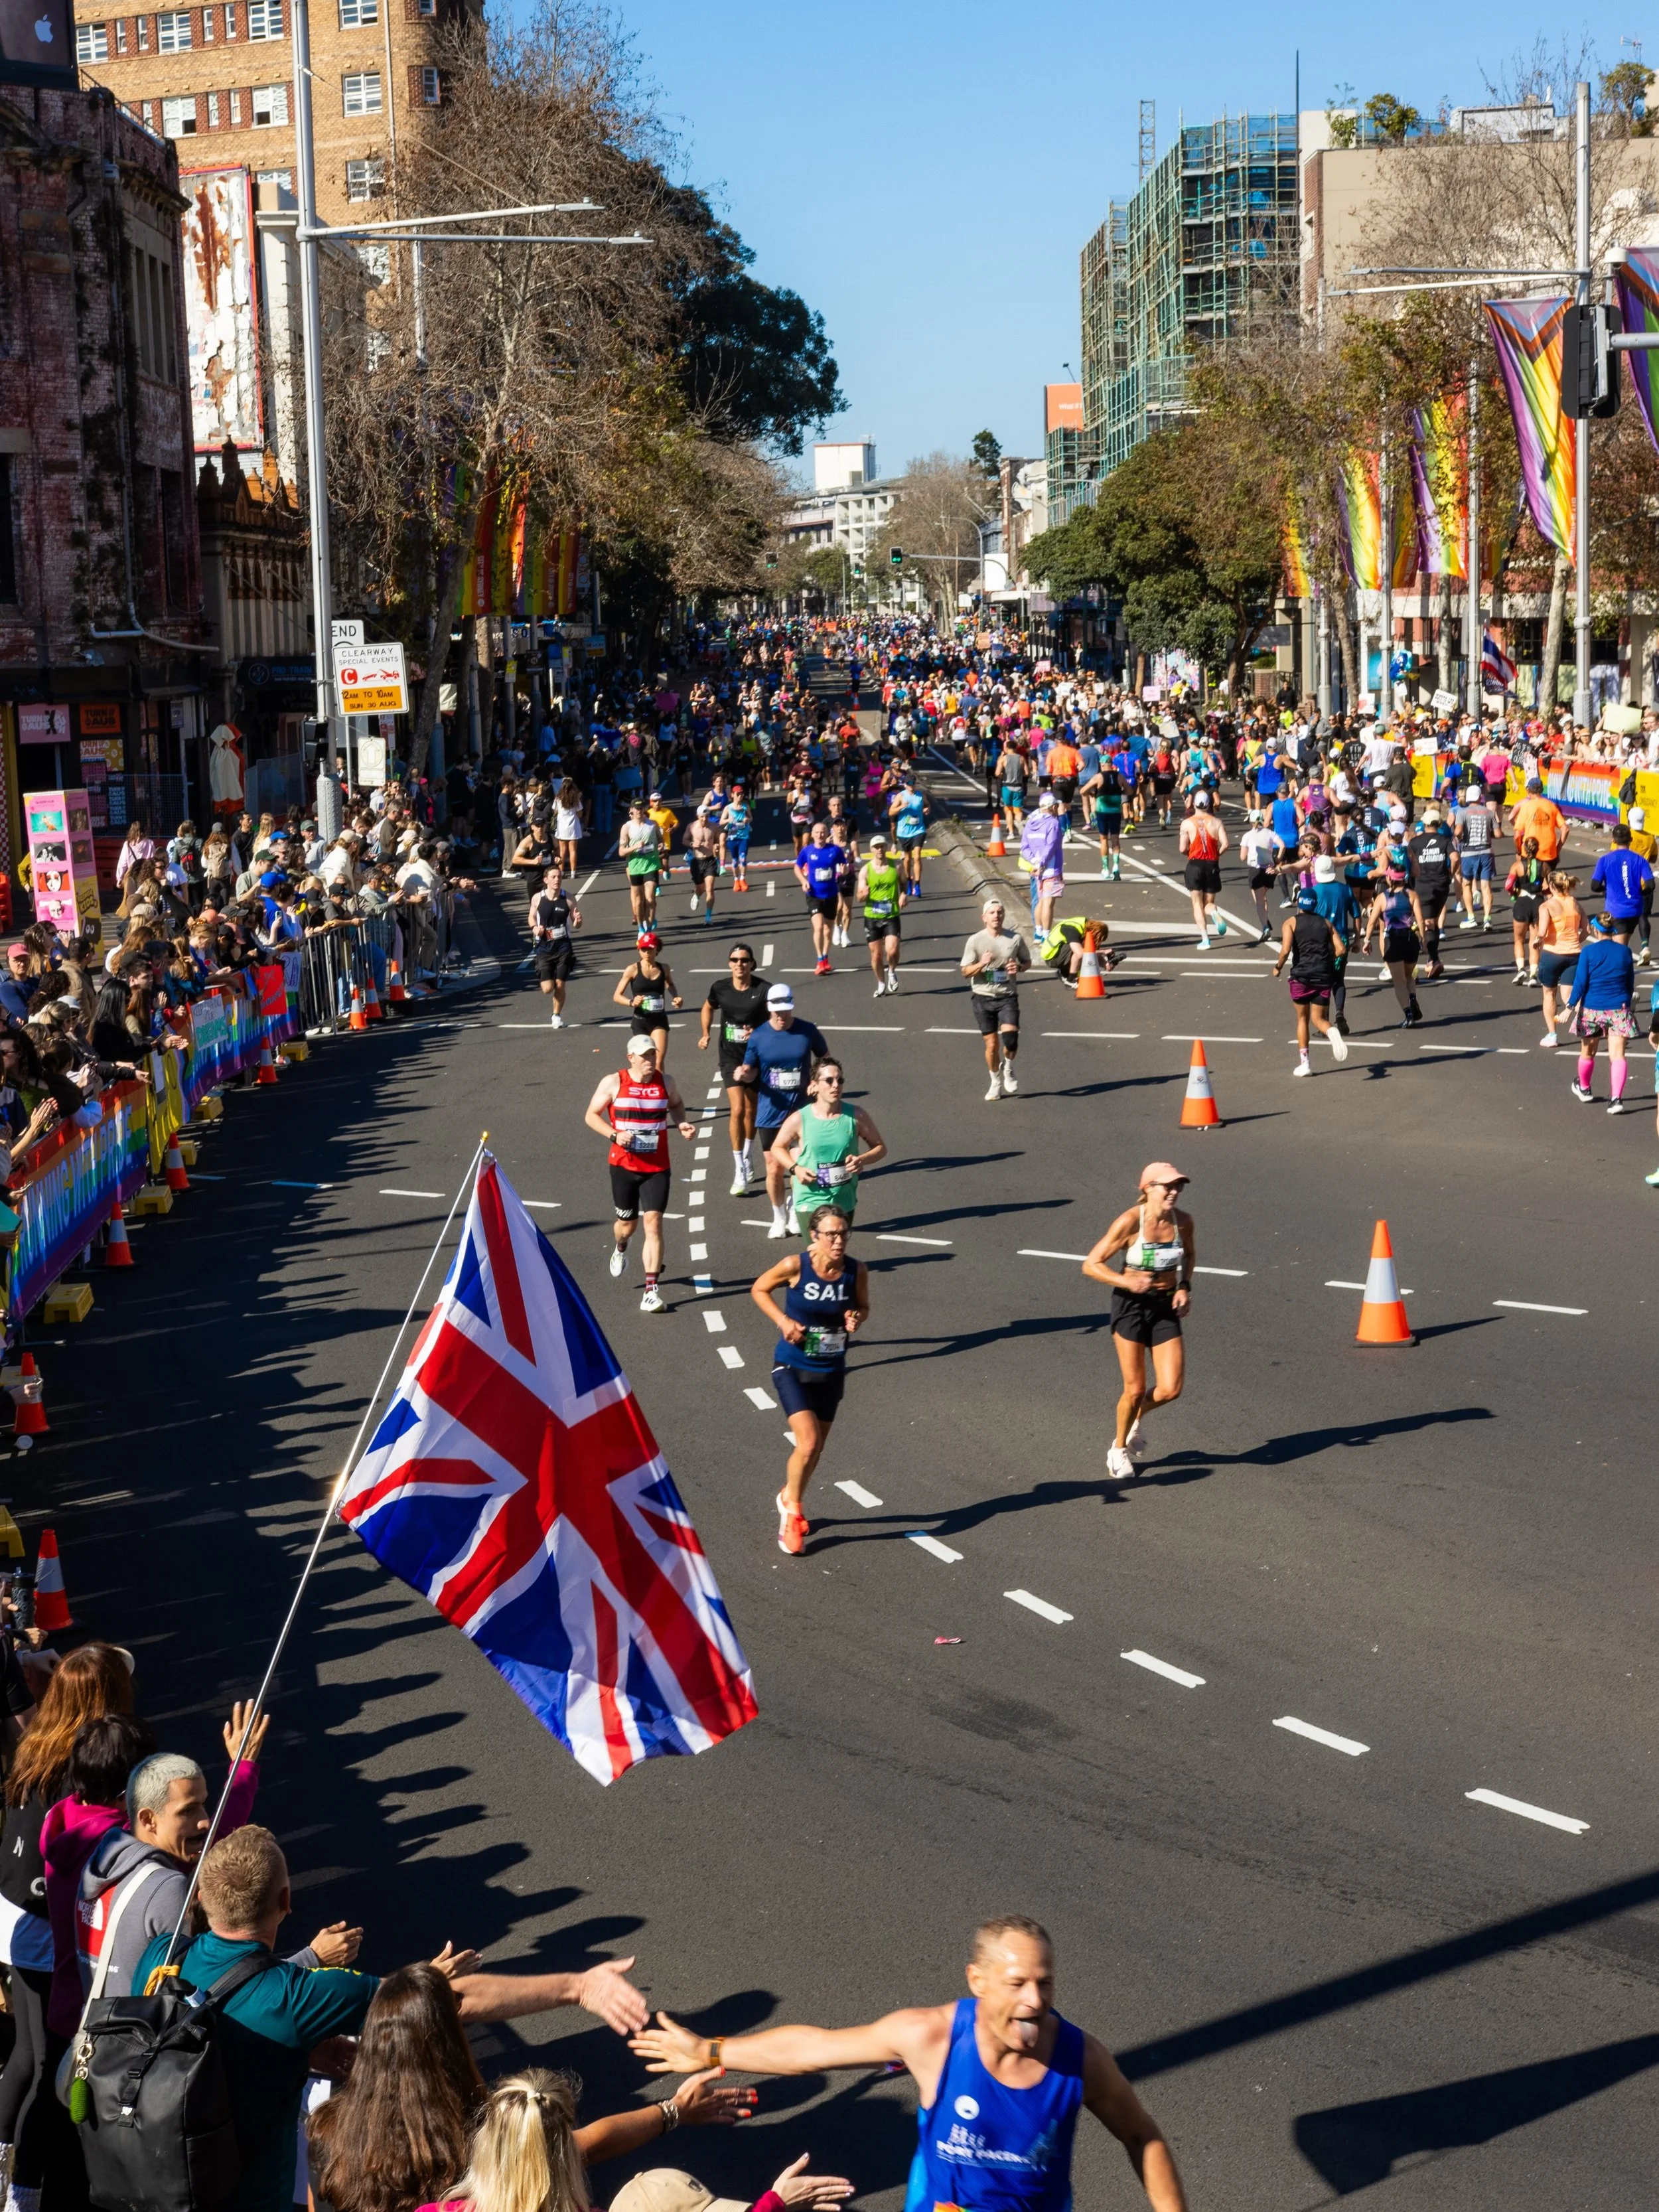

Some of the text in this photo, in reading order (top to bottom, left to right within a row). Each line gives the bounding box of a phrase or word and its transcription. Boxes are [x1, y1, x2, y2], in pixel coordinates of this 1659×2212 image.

[332, 625, 356, 636] END
[341, 648, 393, 657] CLEARWAY
[342, 691, 358, 700] 12AM
[70, 1130, 98, 1218] WITH
[100, 1104, 132, 1189] PRIDE
[804, 1282, 849, 1301] SAL
[13, 1836, 25, 1857] N
